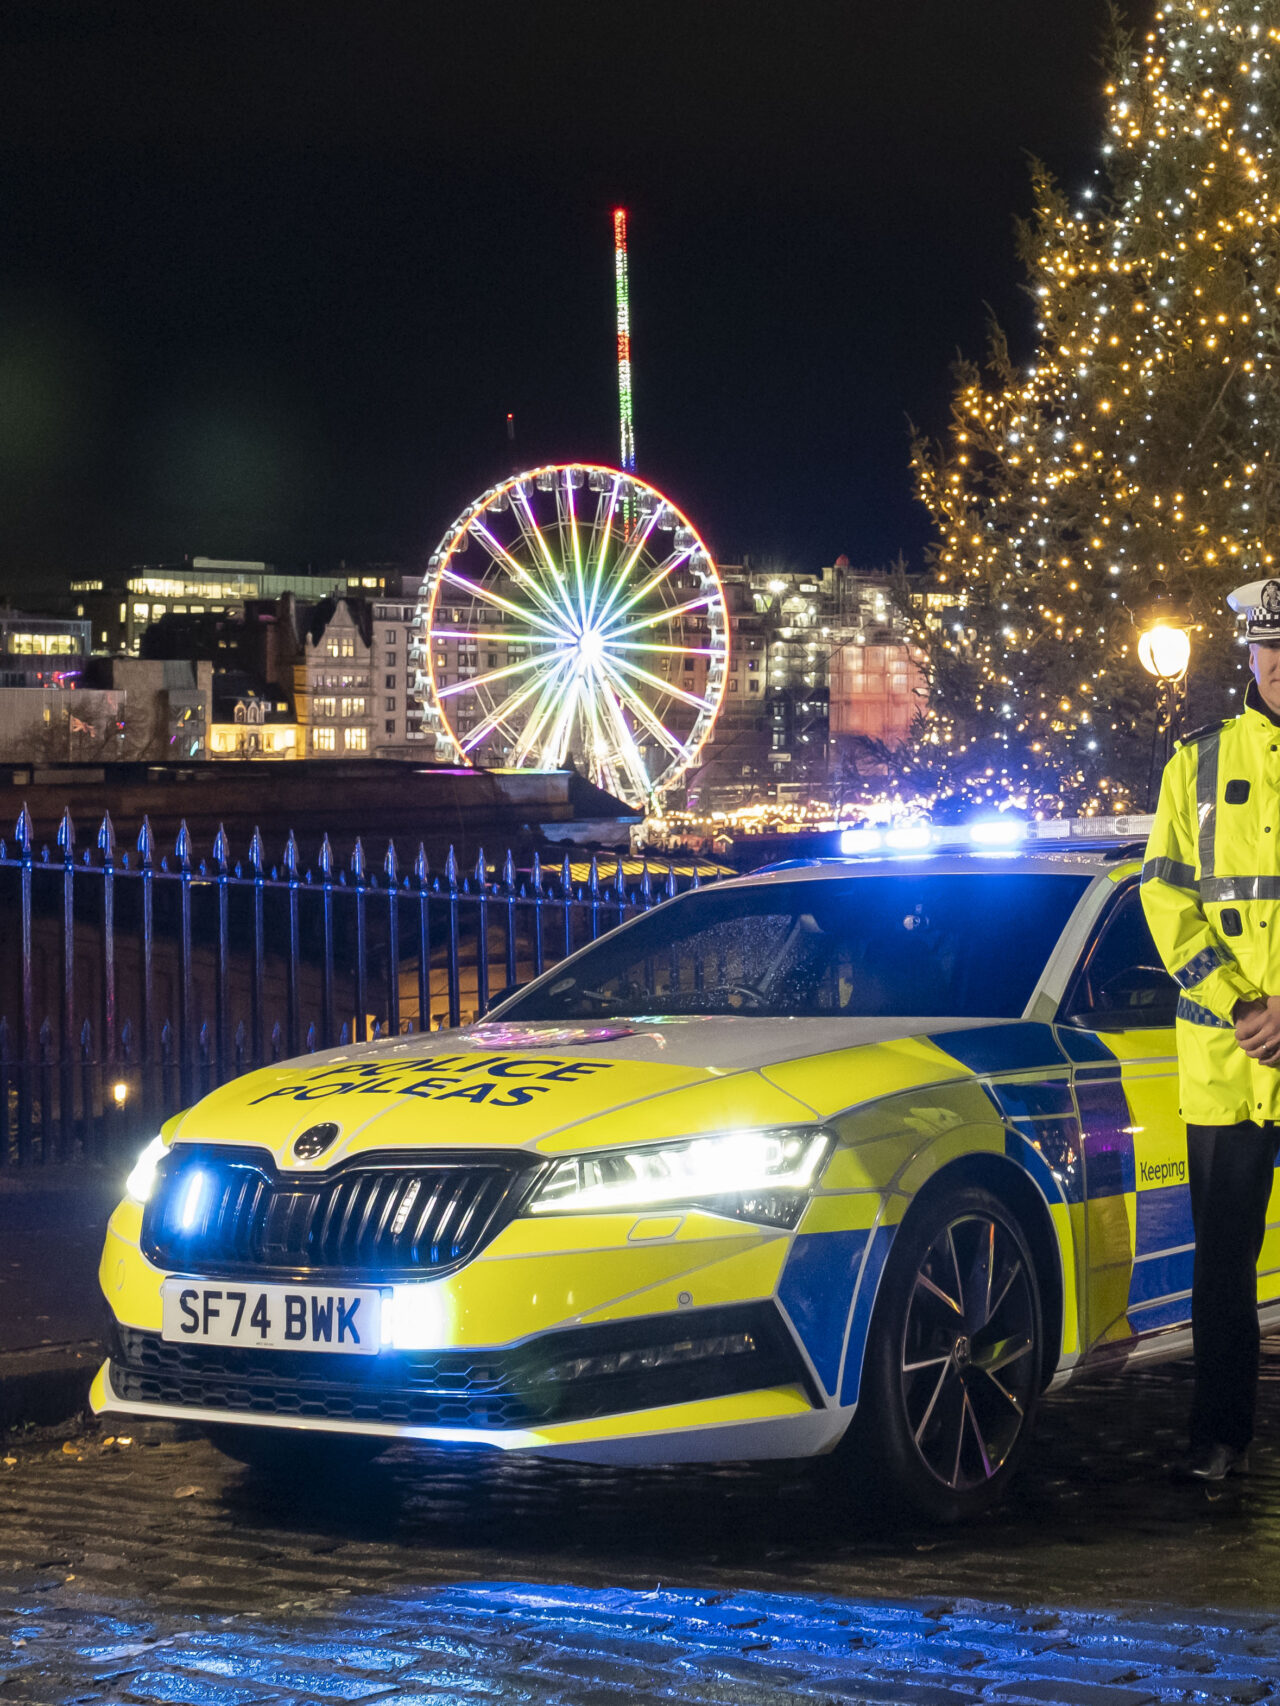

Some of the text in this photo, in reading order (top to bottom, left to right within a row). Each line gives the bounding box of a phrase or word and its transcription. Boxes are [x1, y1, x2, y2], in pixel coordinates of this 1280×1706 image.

[304, 1056, 615, 1082] POLICE
[248, 1077, 551, 1107] POILEAS
[1140, 1157, 1186, 1184] Keeping
[179, 1289, 361, 1345] SF74 BWK
